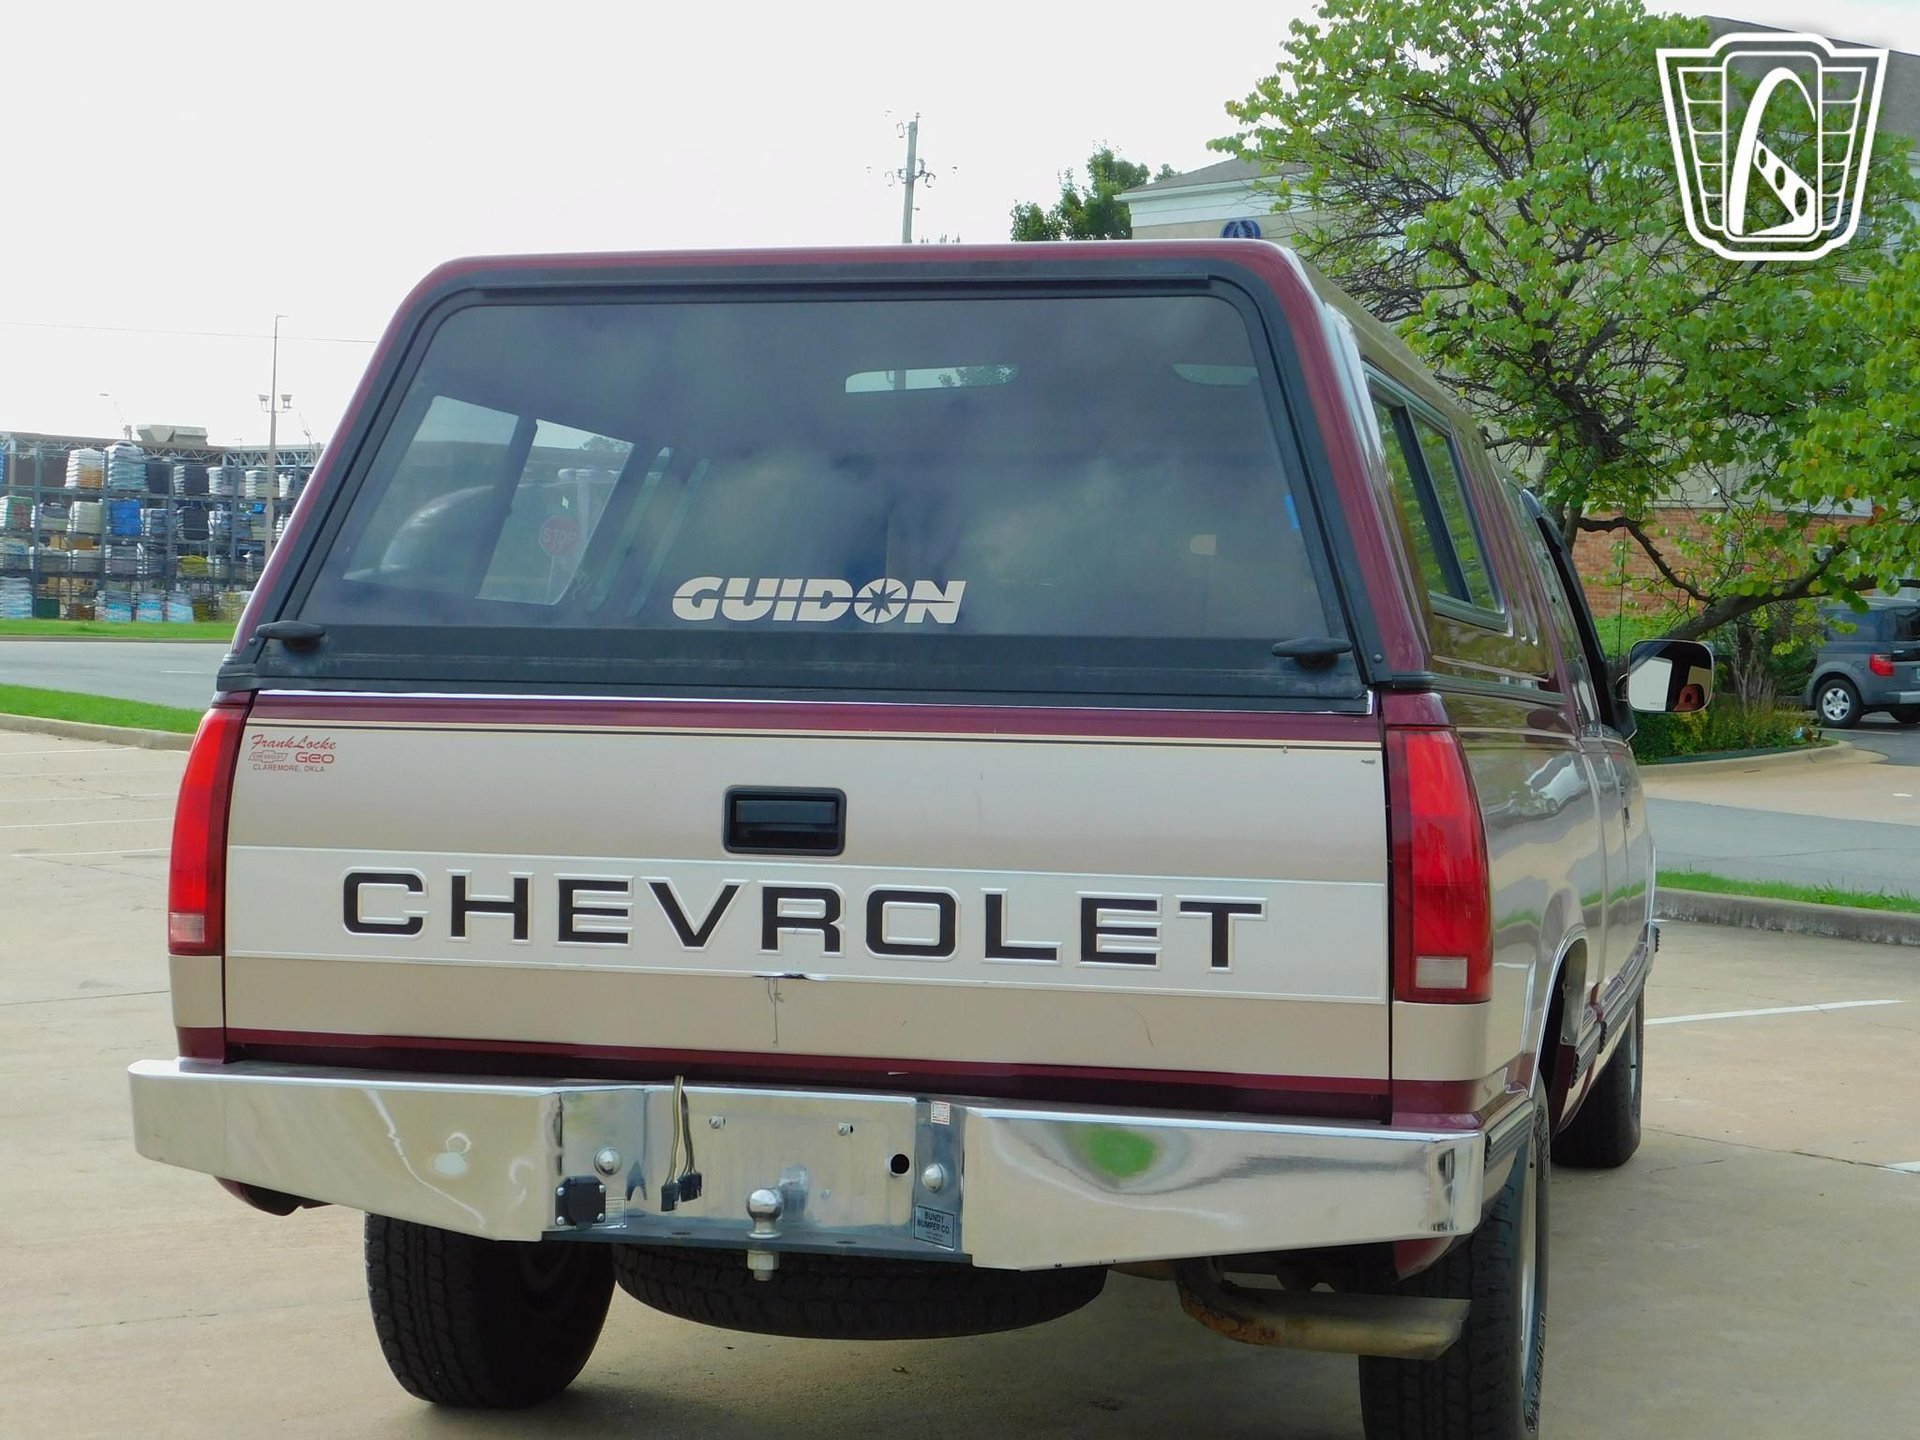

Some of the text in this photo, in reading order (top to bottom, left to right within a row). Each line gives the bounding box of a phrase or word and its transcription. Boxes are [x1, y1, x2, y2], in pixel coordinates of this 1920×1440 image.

[543, 527, 577, 546] STOP
[672, 576, 967, 625] GUIDON
[250, 734, 337, 750] Frank Locke
[342, 868, 1267, 974] CHEVROLET
[917, 1218, 941, 1231] BUMPER
